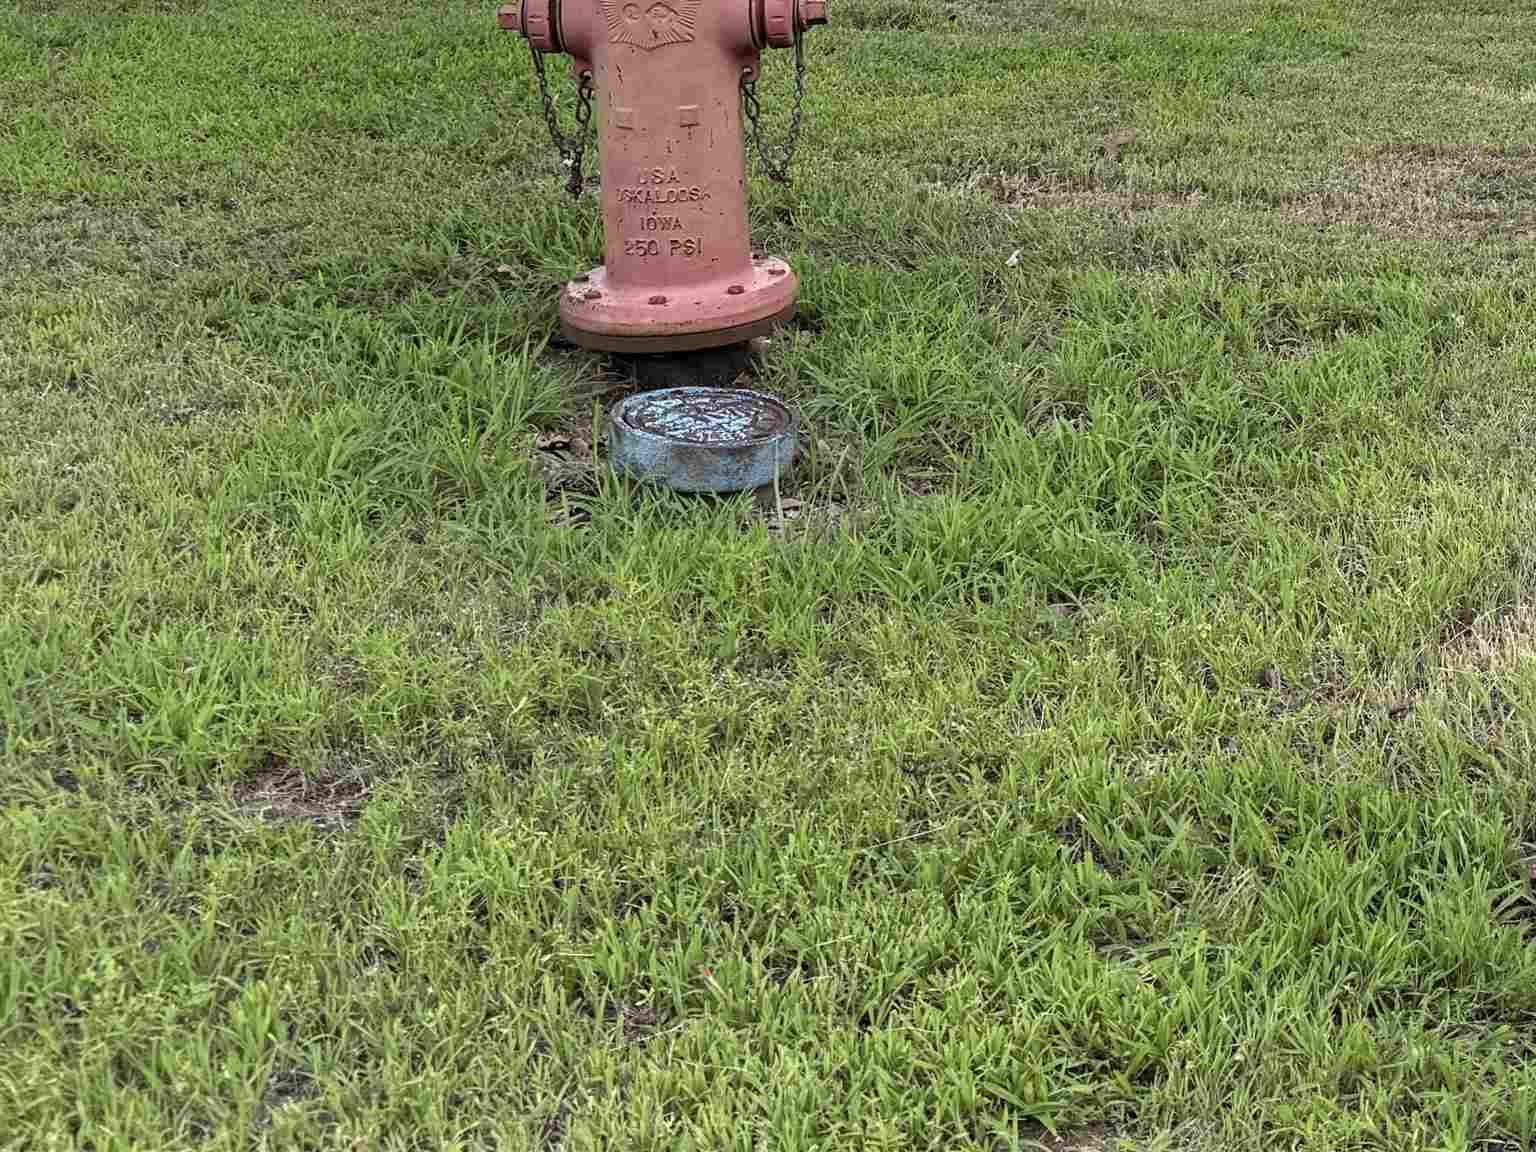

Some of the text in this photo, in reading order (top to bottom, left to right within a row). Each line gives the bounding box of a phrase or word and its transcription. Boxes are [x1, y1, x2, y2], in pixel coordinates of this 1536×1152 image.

[639, 167, 680, 184] USA
[640, 216, 684, 231] IOWA
[624, 236, 705, 257] 250 PSI
